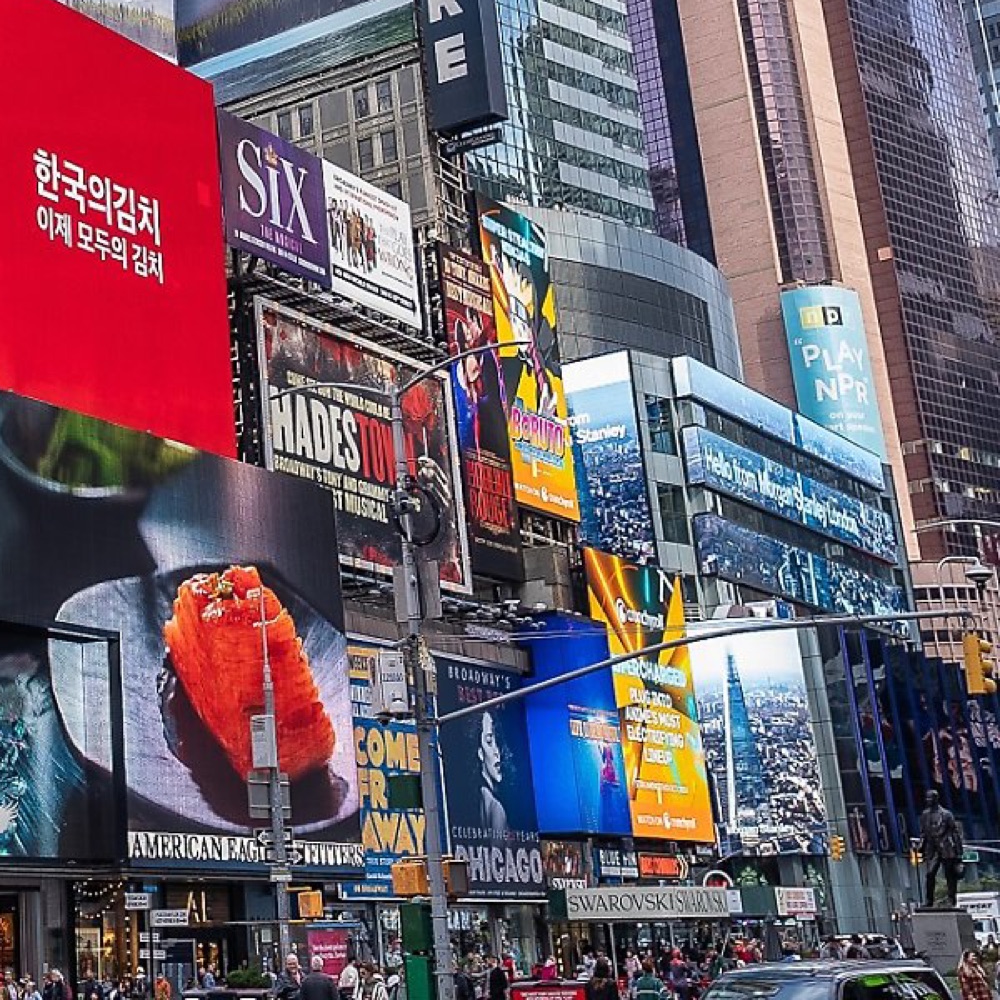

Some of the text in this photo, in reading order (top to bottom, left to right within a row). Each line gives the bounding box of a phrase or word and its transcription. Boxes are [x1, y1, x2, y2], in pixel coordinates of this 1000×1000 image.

[236, 139, 318, 244] SIX
[36, 205, 164, 284] 이제 모두의 김치
[704, 446, 860, 536] Hello from Morgan Stanley London
[448, 666, 511, 689] BROADWAY'S
[355, 726, 421, 772] COME
[130, 832, 223, 861] AMERICAN
[361, 811, 425, 856] AWAY
[569, 891, 675, 913] SWAROVSKI
